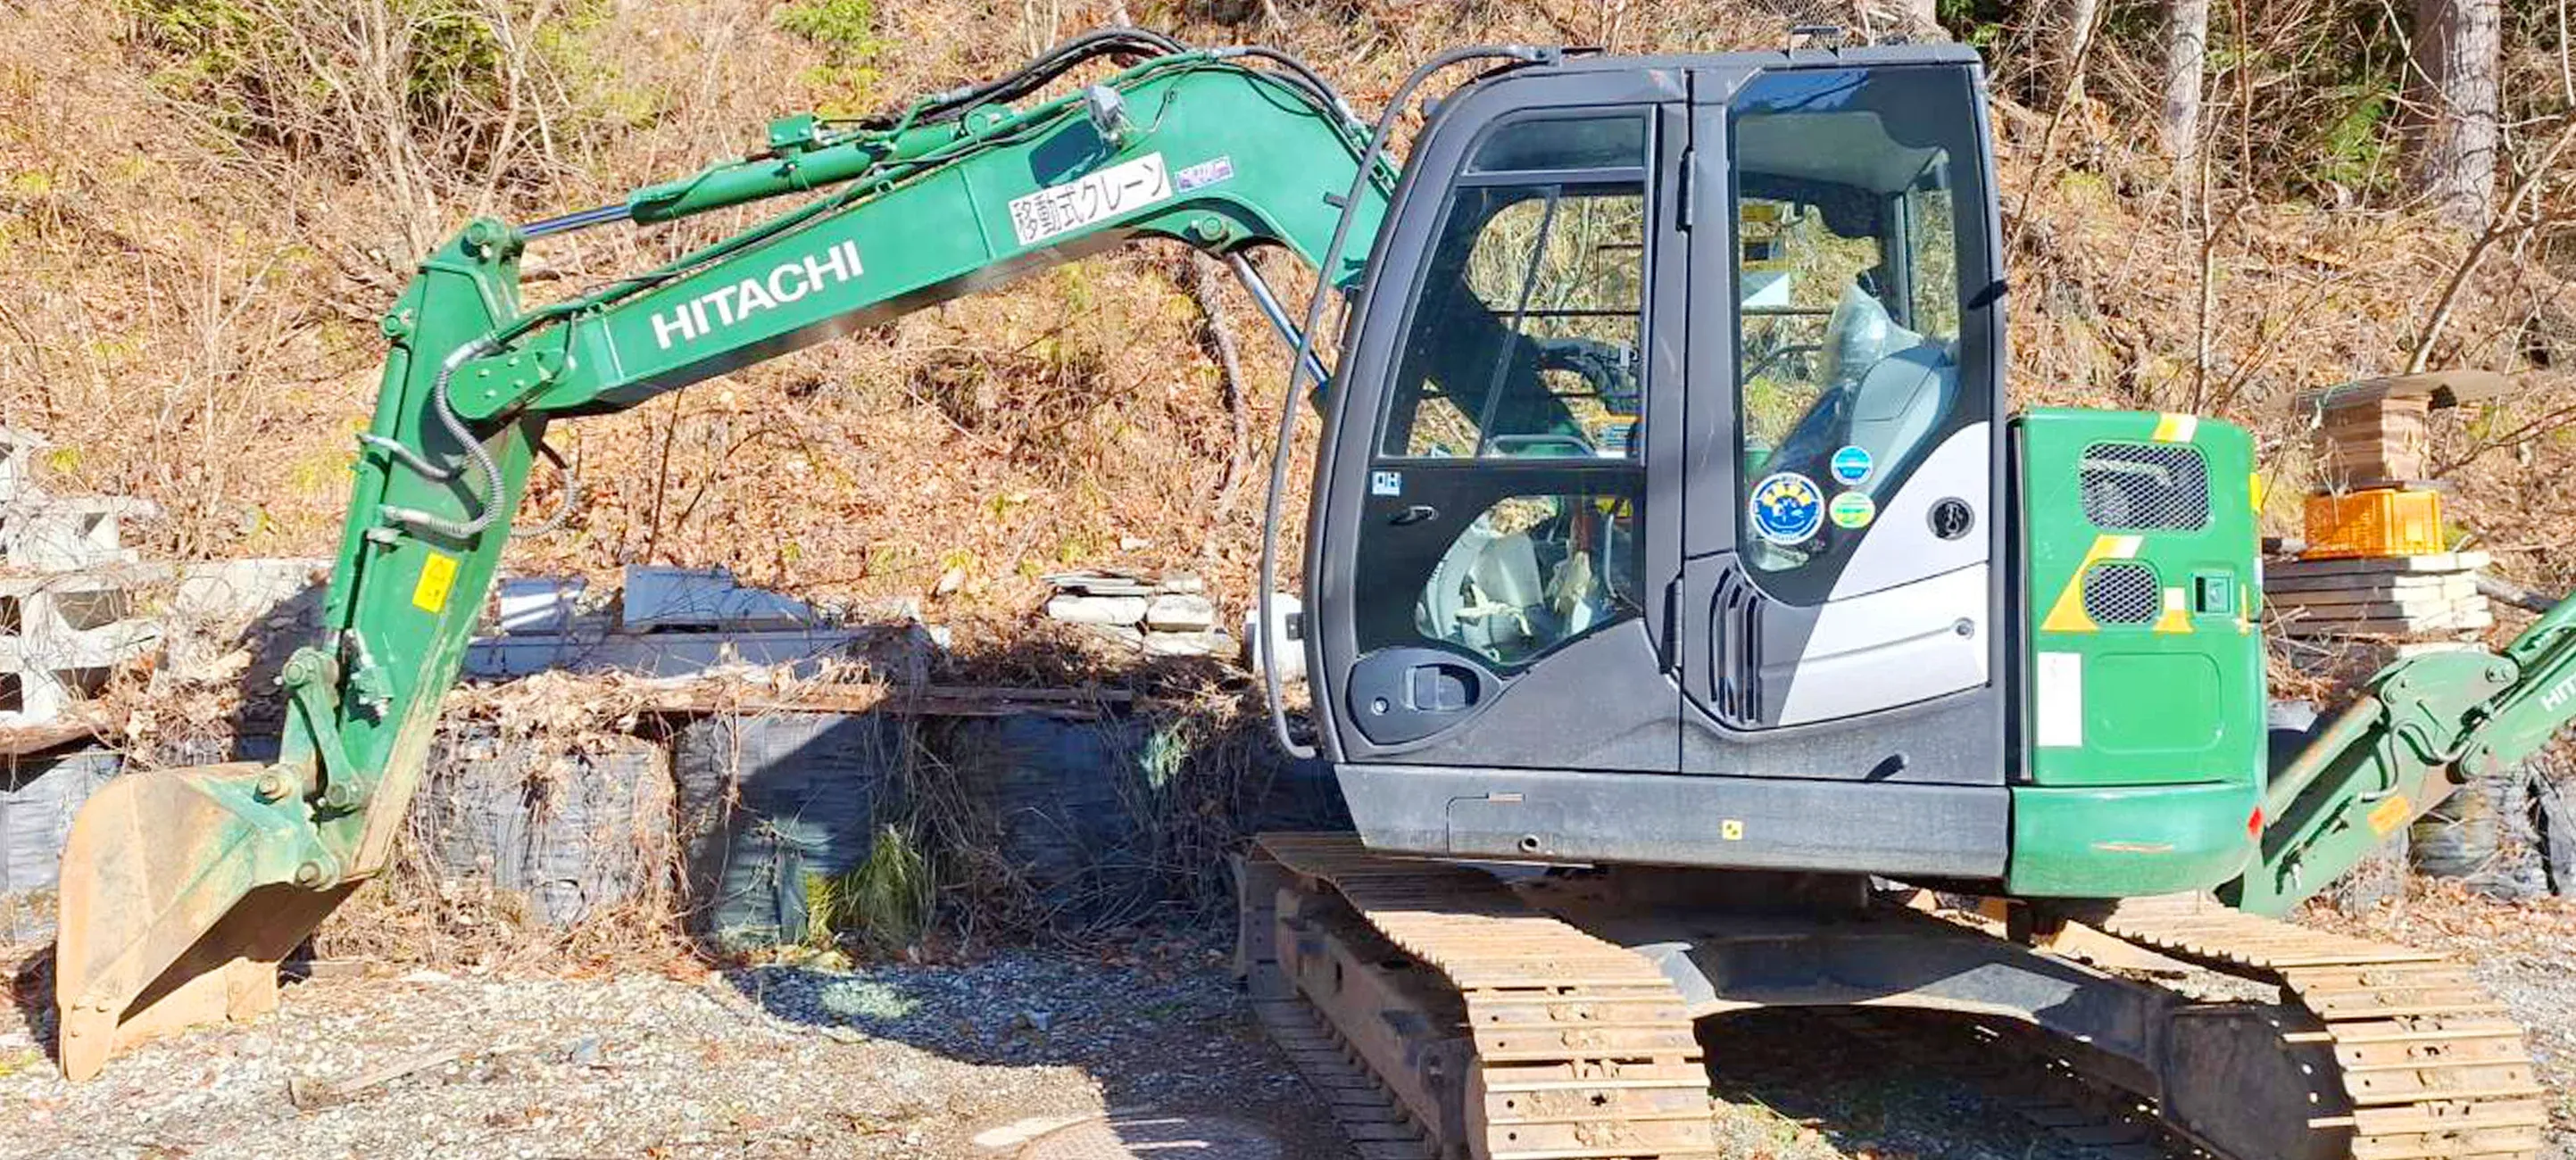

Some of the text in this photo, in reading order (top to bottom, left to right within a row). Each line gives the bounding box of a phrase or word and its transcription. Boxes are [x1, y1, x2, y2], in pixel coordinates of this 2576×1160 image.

[1013, 162, 1163, 240] 移動式クレーン
[652, 239, 863, 349] HITACHI
